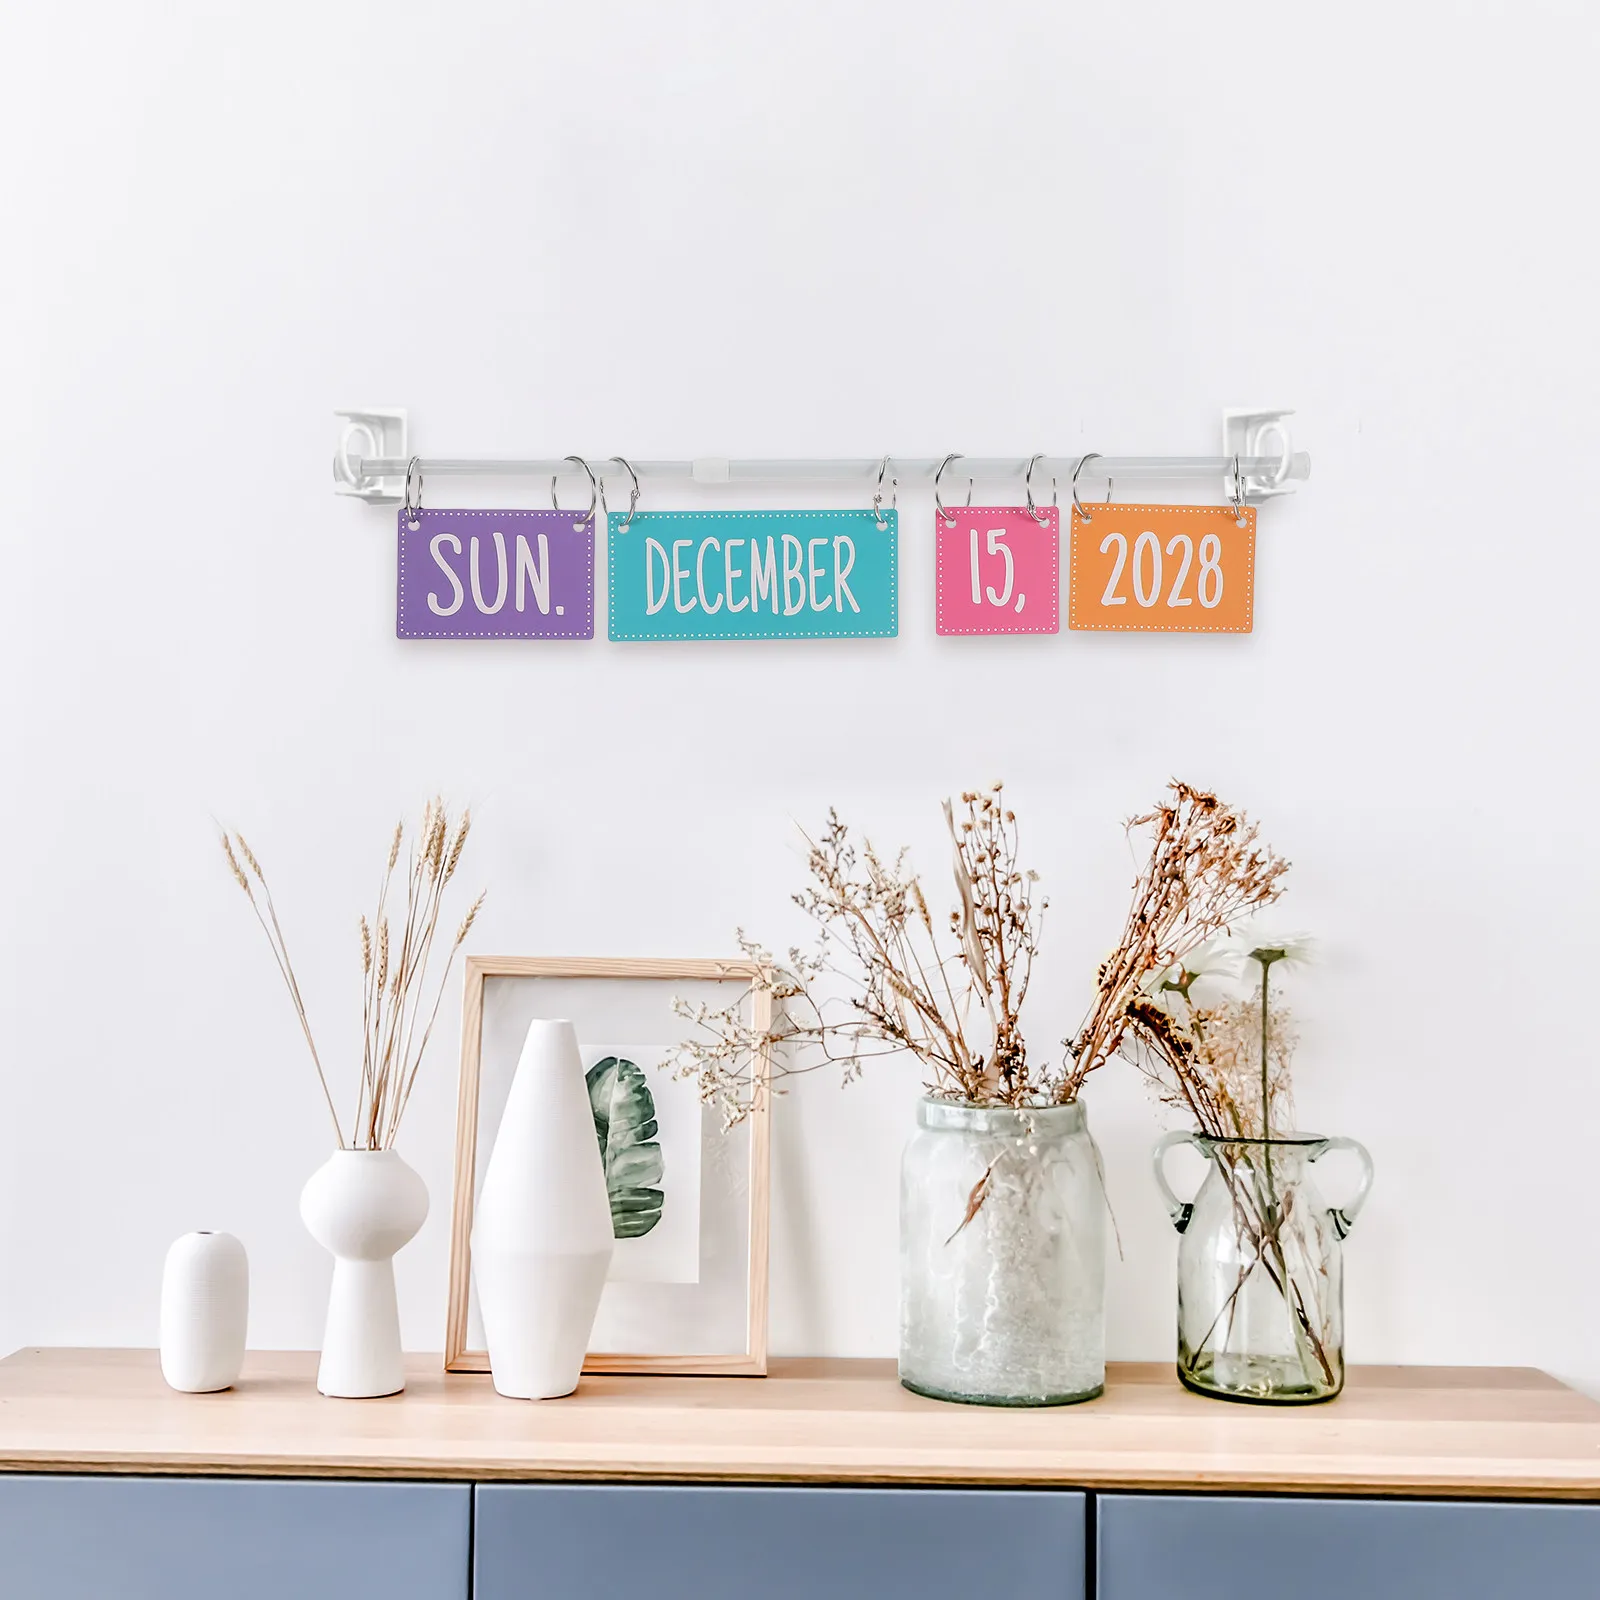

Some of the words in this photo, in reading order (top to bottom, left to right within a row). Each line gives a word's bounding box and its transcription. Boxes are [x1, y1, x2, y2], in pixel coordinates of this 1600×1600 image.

[427, 532, 566, 617] SUN.
[645, 535, 861, 616] DECEMBER
[969, 528, 1026, 614] 15,
[1099, 531, 1224, 609] 2028
